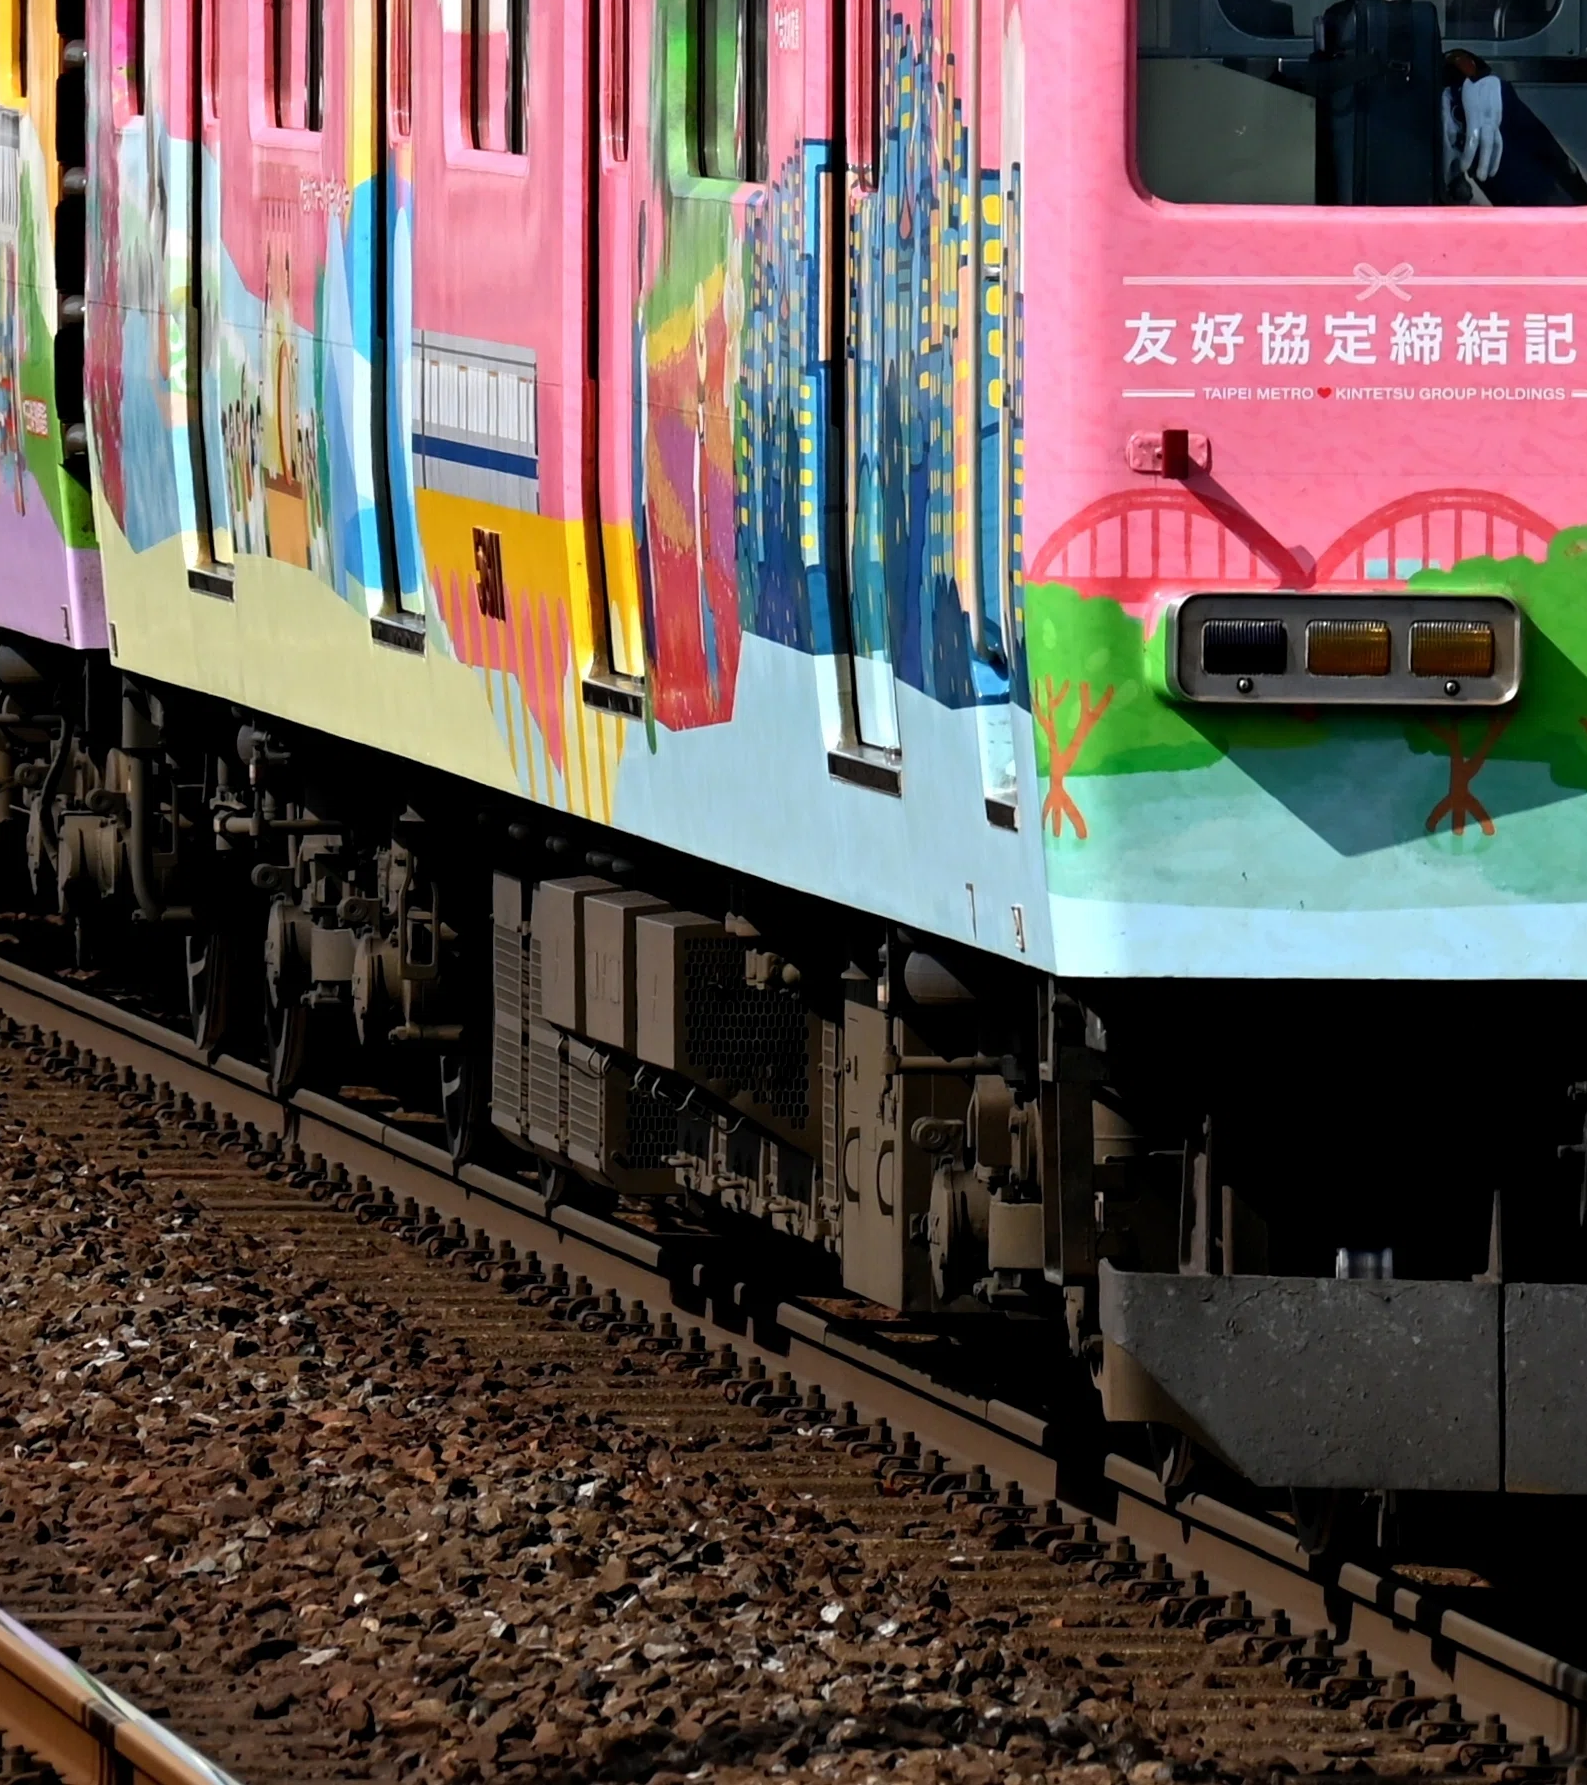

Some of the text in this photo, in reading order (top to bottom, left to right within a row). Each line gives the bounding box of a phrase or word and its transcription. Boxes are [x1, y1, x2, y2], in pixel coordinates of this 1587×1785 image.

[1203, 386, 1566, 401] TAIPEI METRO KINTETSU GROUP HOLDINGS
